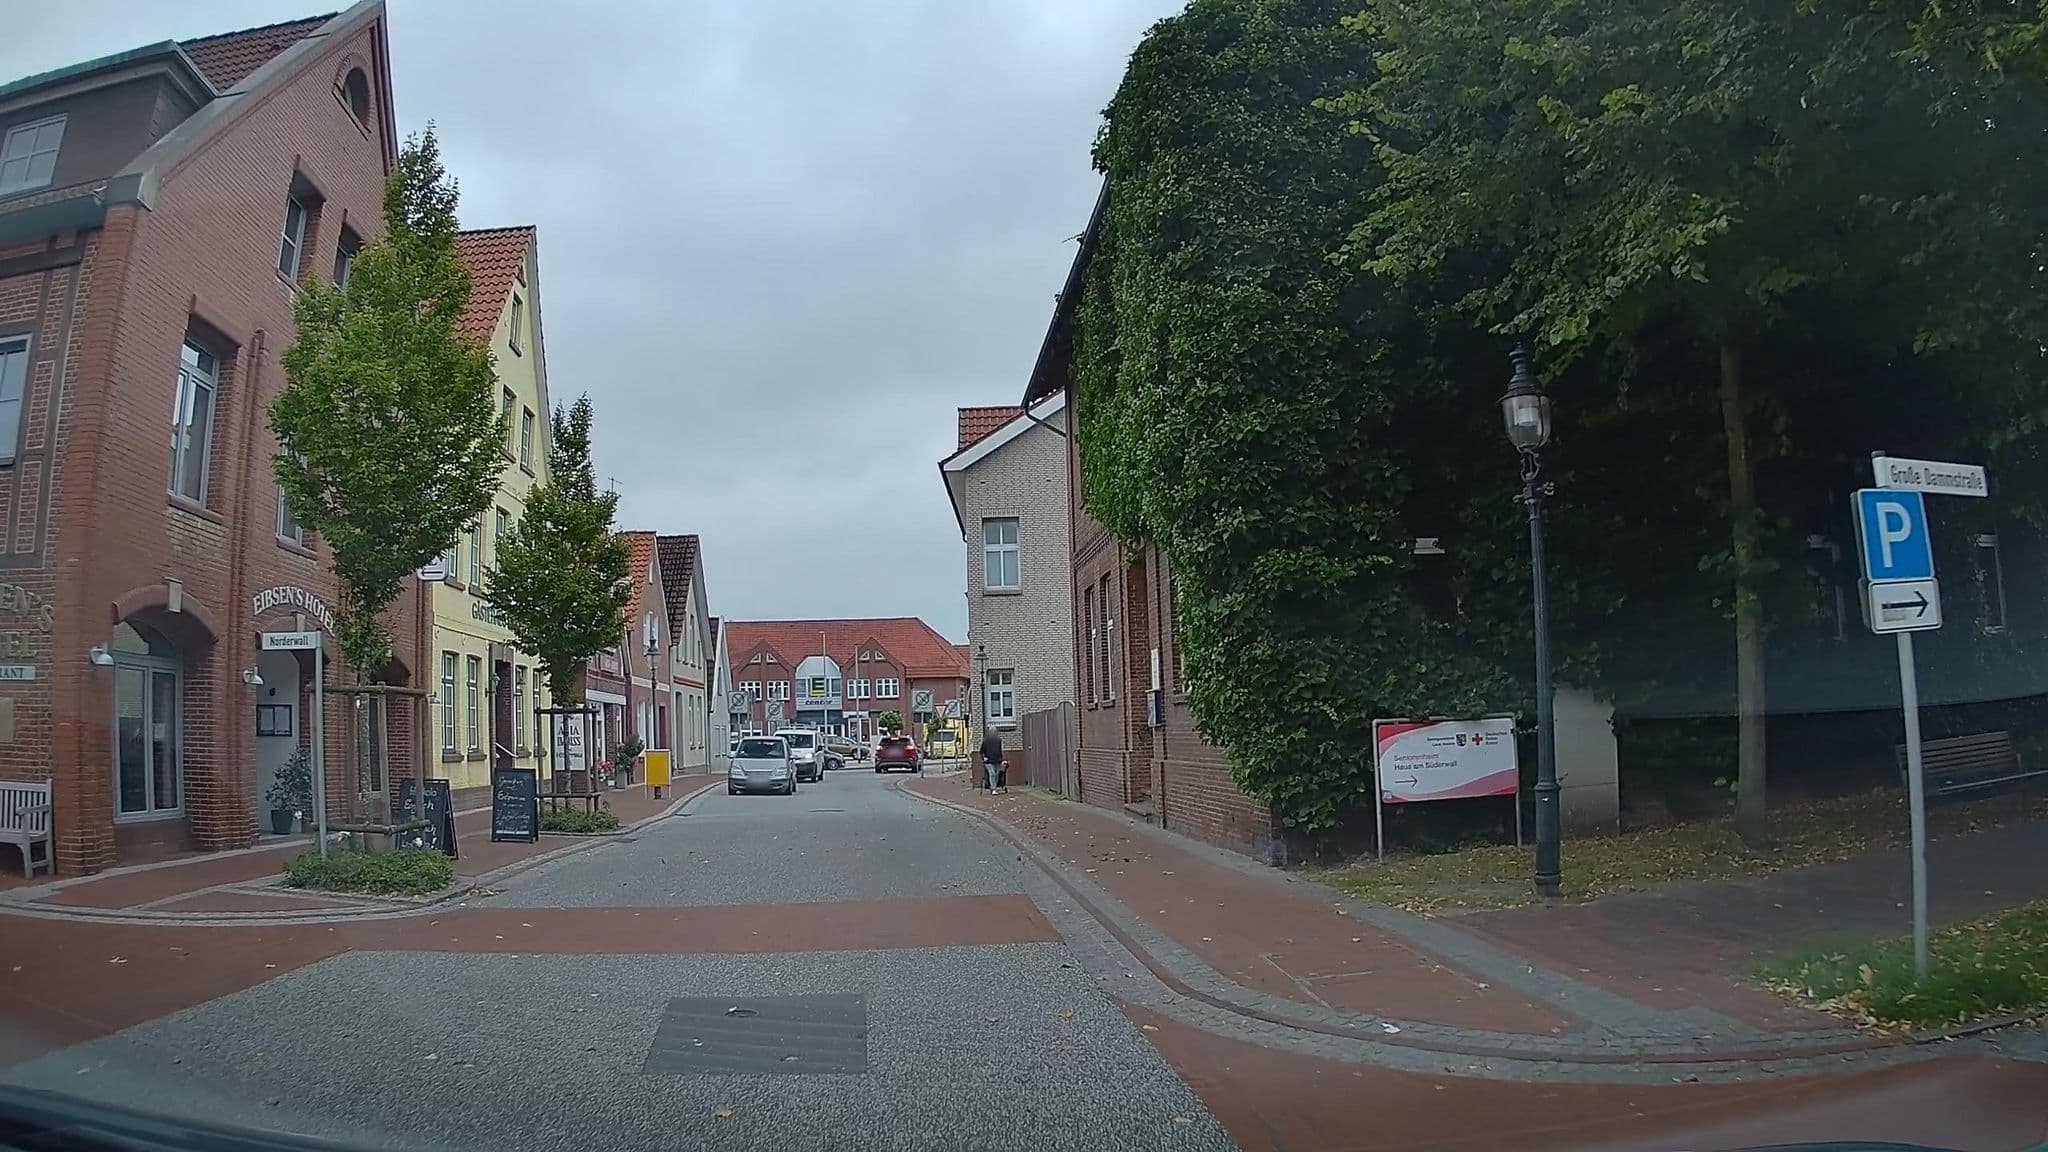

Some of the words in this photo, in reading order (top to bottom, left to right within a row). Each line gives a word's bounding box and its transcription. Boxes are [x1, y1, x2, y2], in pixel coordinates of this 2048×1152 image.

[1890, 464, 1921, 485] Große
[1924, 467, 1983, 490] Dammstraße
[1876, 502, 1912, 568] P
[252, 586, 304, 616] EIBSEN'S
[304, 592, 336, 637] HOTEL
[269, 635, 309, 646] Norderwall
[558, 725, 580, 735] AIA
[1393, 753, 1440, 762] Seniorenheim
